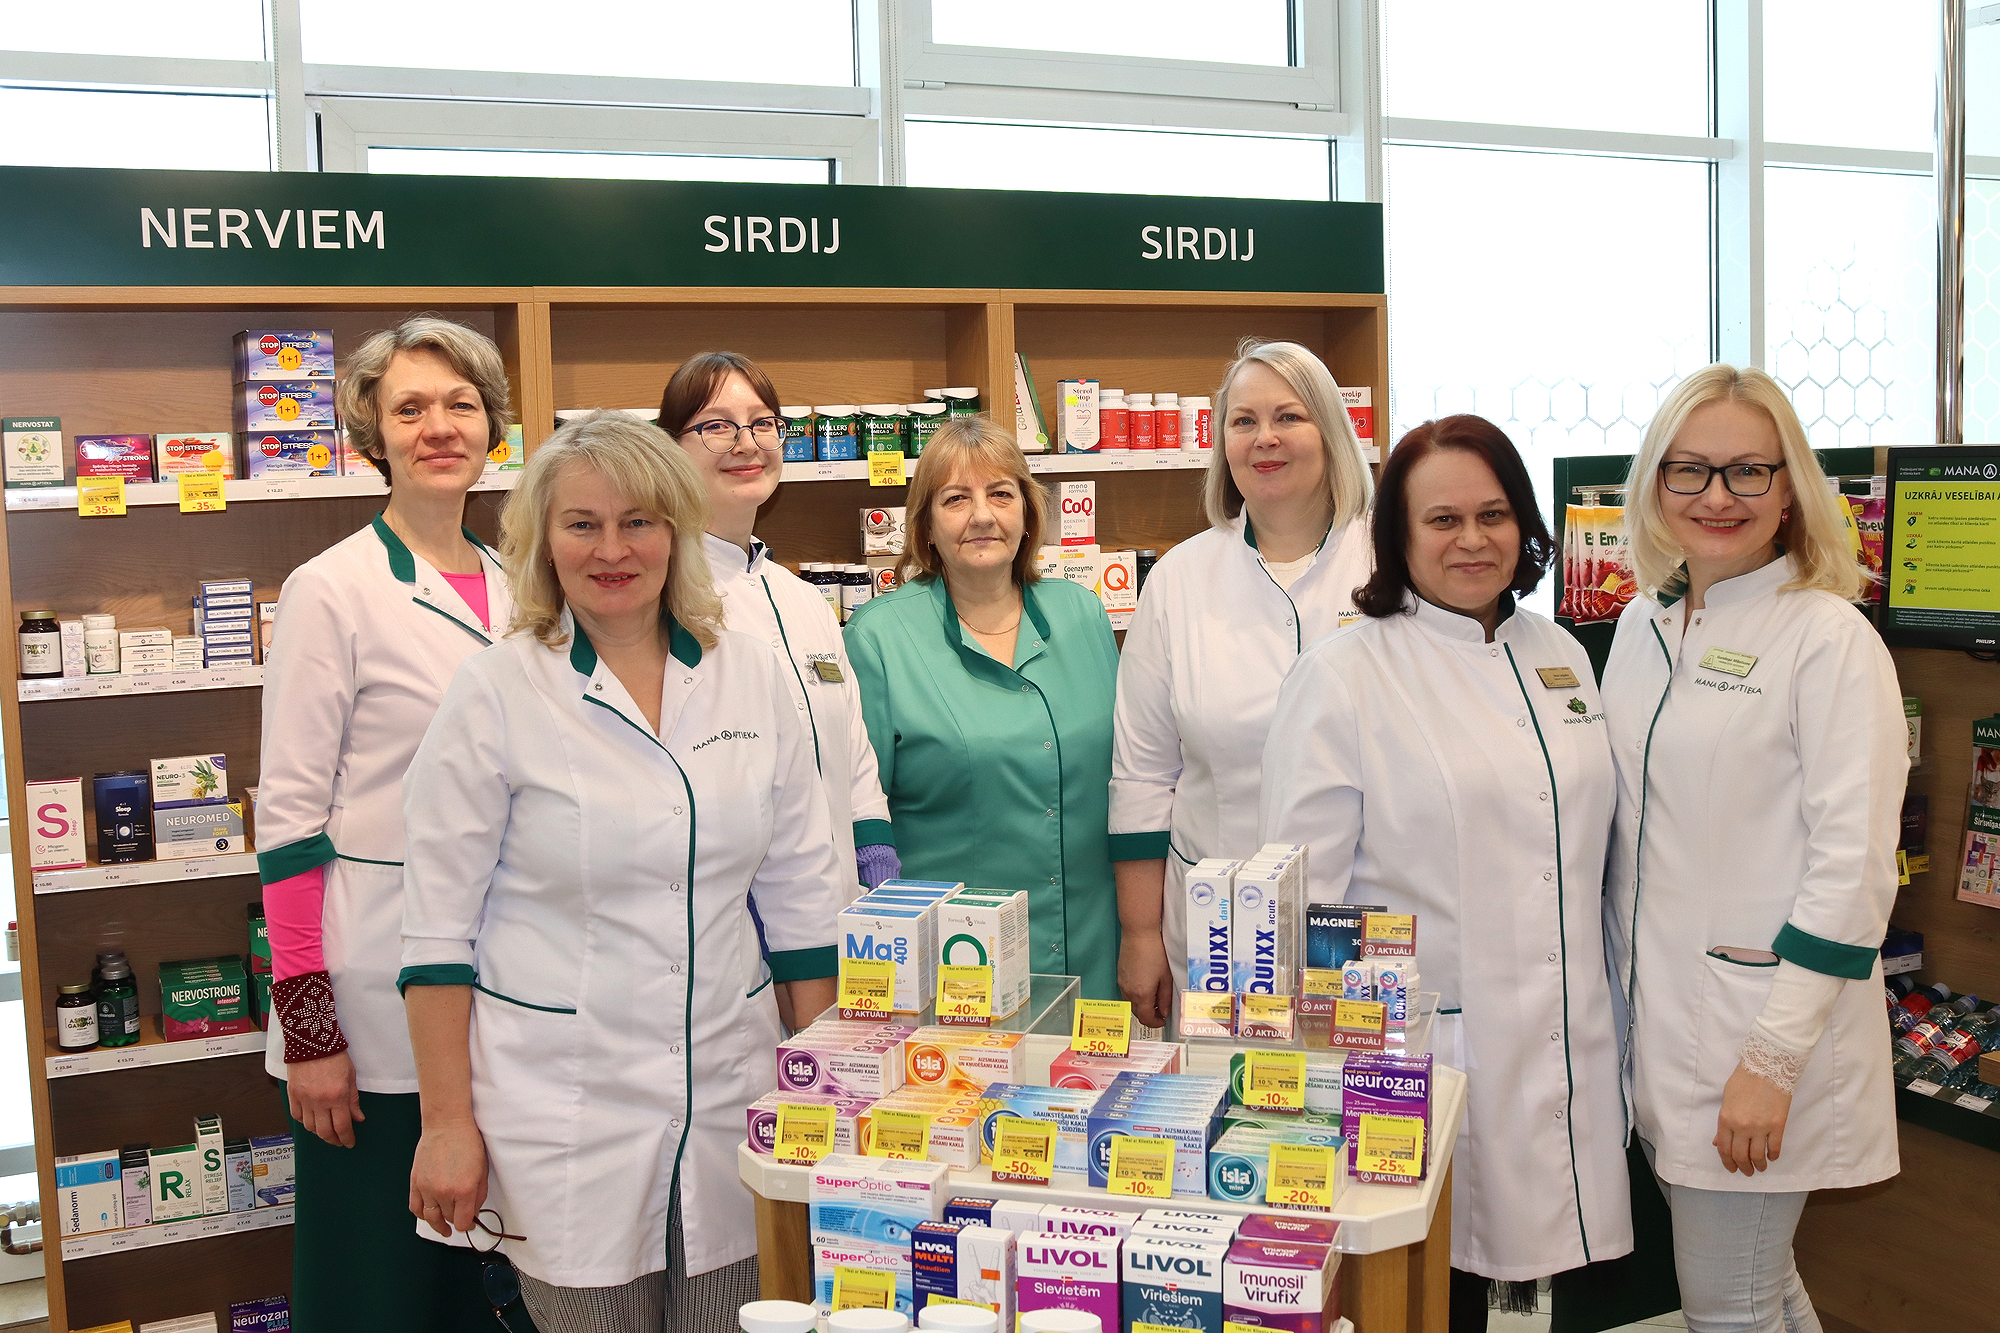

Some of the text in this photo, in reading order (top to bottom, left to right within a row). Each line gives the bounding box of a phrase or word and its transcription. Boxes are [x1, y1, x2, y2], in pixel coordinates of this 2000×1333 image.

[141, 208, 385, 249] NERVIEM
[704, 215, 840, 254] SIRDIJ
[1141, 225, 1255, 262] SIRDIJ
[281, 355, 299, 364] 1+1
[1072, 387, 1093, 395] Sterol
[279, 405, 297, 415] 1+1
[282, 442, 315, 450] STRESS
[310, 452, 328, 462] 1+1
[1944, 465, 1981, 476] MANA
[878, 477, 898, 485] -40%
[1904, 489, 1995, 501] UZKRĀJ VESELĪBAI
[90, 505, 115, 515] -35%
[192, 501, 216, 511] -35%
[1856, 517, 1885, 532] Em-eu
[1063, 565, 1094, 574] Coenzyme
[1103, 563, 1130, 591] Q
[1694, 677, 1763, 695] MANA APTIEKA
[692, 730, 760, 752] MANA APTIEKA
[156, 772, 186, 780] NEURO-3
[37, 803, 70, 839] S
[166, 812, 230, 827] NEUROMED
[1902, 813, 1920, 823] durex
[1219, 897, 1229, 921] daily
[1268, 899, 1276, 925] acute
[893, 936, 908, 966] 400
[987, 936, 996, 959] Strong
[1377, 947, 1412, 956] AKTUĀLI
[1205, 925, 1229, 992] QUIXX
[1249, 929, 1275, 995] QUIXX
[171, 984, 240, 1003] NERVOSTRONG
[849, 998, 880, 1010] -40%
[948, 1004, 979, 1015] -40%
[1394, 986, 1406, 1021] QUIXX
[1196, 1026, 1231, 1035] AKTUĀLI
[1255, 1029, 1290, 1039] AKTUĀLI
[1083, 1040, 1114, 1053] -50%
[1346, 1036, 1381, 1046] AKTUĀLI
[916, 1054, 943, 1071] isla
[977, 1056, 1009, 1064] AIZSMAKUMU
[787, 1060, 814, 1076] isla
[920, 1071, 939, 1079] ginger
[1308, 1077, 1341, 1085] AIZSMAKUMU
[1344, 1073, 1426, 1092] Neurozan
[1260, 1092, 1290, 1106] -10%
[1391, 1090, 1425, 1099] ORIGINAL
[1032, 1110, 1080, 1120] SAAUKSTĒŠANOS
[933, 1134, 964, 1142] AIZSMAKUMU
[1164, 1127, 1203, 1136] AIZSMAKUMU
[1183, 1141, 1203, 1149] KAKLĀ
[259, 1154, 291, 1164] SERENITAS
[789, 1146, 817, 1159] -10%
[203, 1148, 221, 1172] S
[1372, 1158, 1406, 1174] -25%
[1005, 1160, 1037, 1176] -50%
[1221, 1166, 1251, 1185] isla
[159, 1170, 185, 1202] R
[815, 1175, 893, 1192] SuperOptic
[1125, 1181, 1155, 1195] -10%
[1228, 1184, 1245, 1192] mint
[1283, 1190, 1318, 1204] -20%
[71, 1190, 80, 1233] Sedanorm
[1060, 1207, 1119, 1218] LIVOL
[1163, 1211, 1223, 1221] LIVOL
[921, 1221, 961, 1230] LIVOL
[949, 1216, 988, 1228] LIVOL
[1152, 1223, 1214, 1235] LIVOL
[816, 1236, 826, 1244] 60
[1039, 1233, 1101, 1242] LIVOL
[914, 1241, 954, 1254] LIVOL
[1145, 1238, 1207, 1251] LIVOL
[821, 1249, 898, 1266] SuperOptic
[914, 1251, 954, 1264] MULTI
[1026, 1246, 1108, 1269] LIVOL
[914, 1263, 951, 1274] Pusaudžiem
[1131, 1252, 1212, 1278] LIVOL
[1239, 1270, 1304, 1290] Imunosil
[1034, 1282, 1101, 1298] Sievietēm
[1244, 1286, 1301, 1305] Virufix
[1140, 1287, 1203, 1307] Vīriešiem
[233, 1309, 289, 1328] Neurozan
[267, 1318, 290, 1329] PLUS
